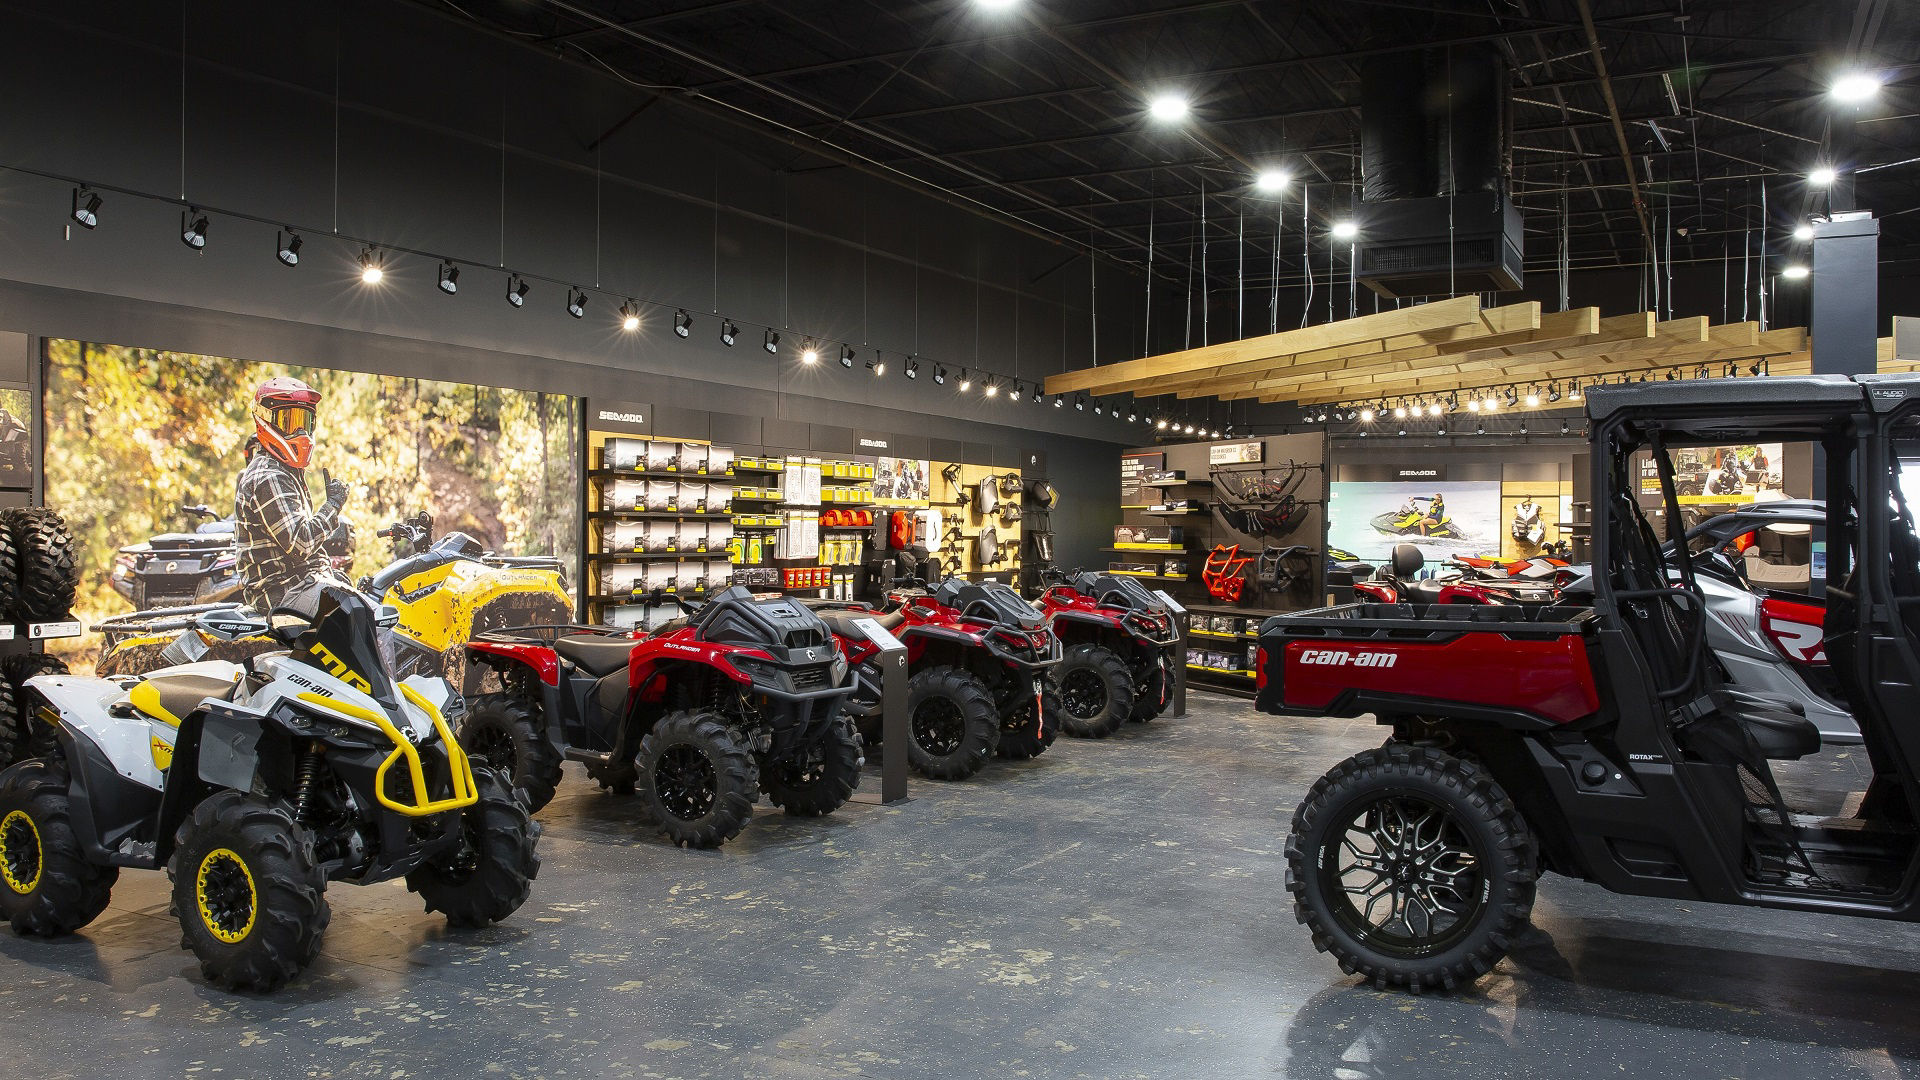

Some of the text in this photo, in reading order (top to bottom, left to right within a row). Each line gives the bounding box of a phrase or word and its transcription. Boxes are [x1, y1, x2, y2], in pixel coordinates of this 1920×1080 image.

[218, 623, 252, 632] can-am
[1300, 650, 1398, 668] can-am
[286, 673, 334, 698] can-am
